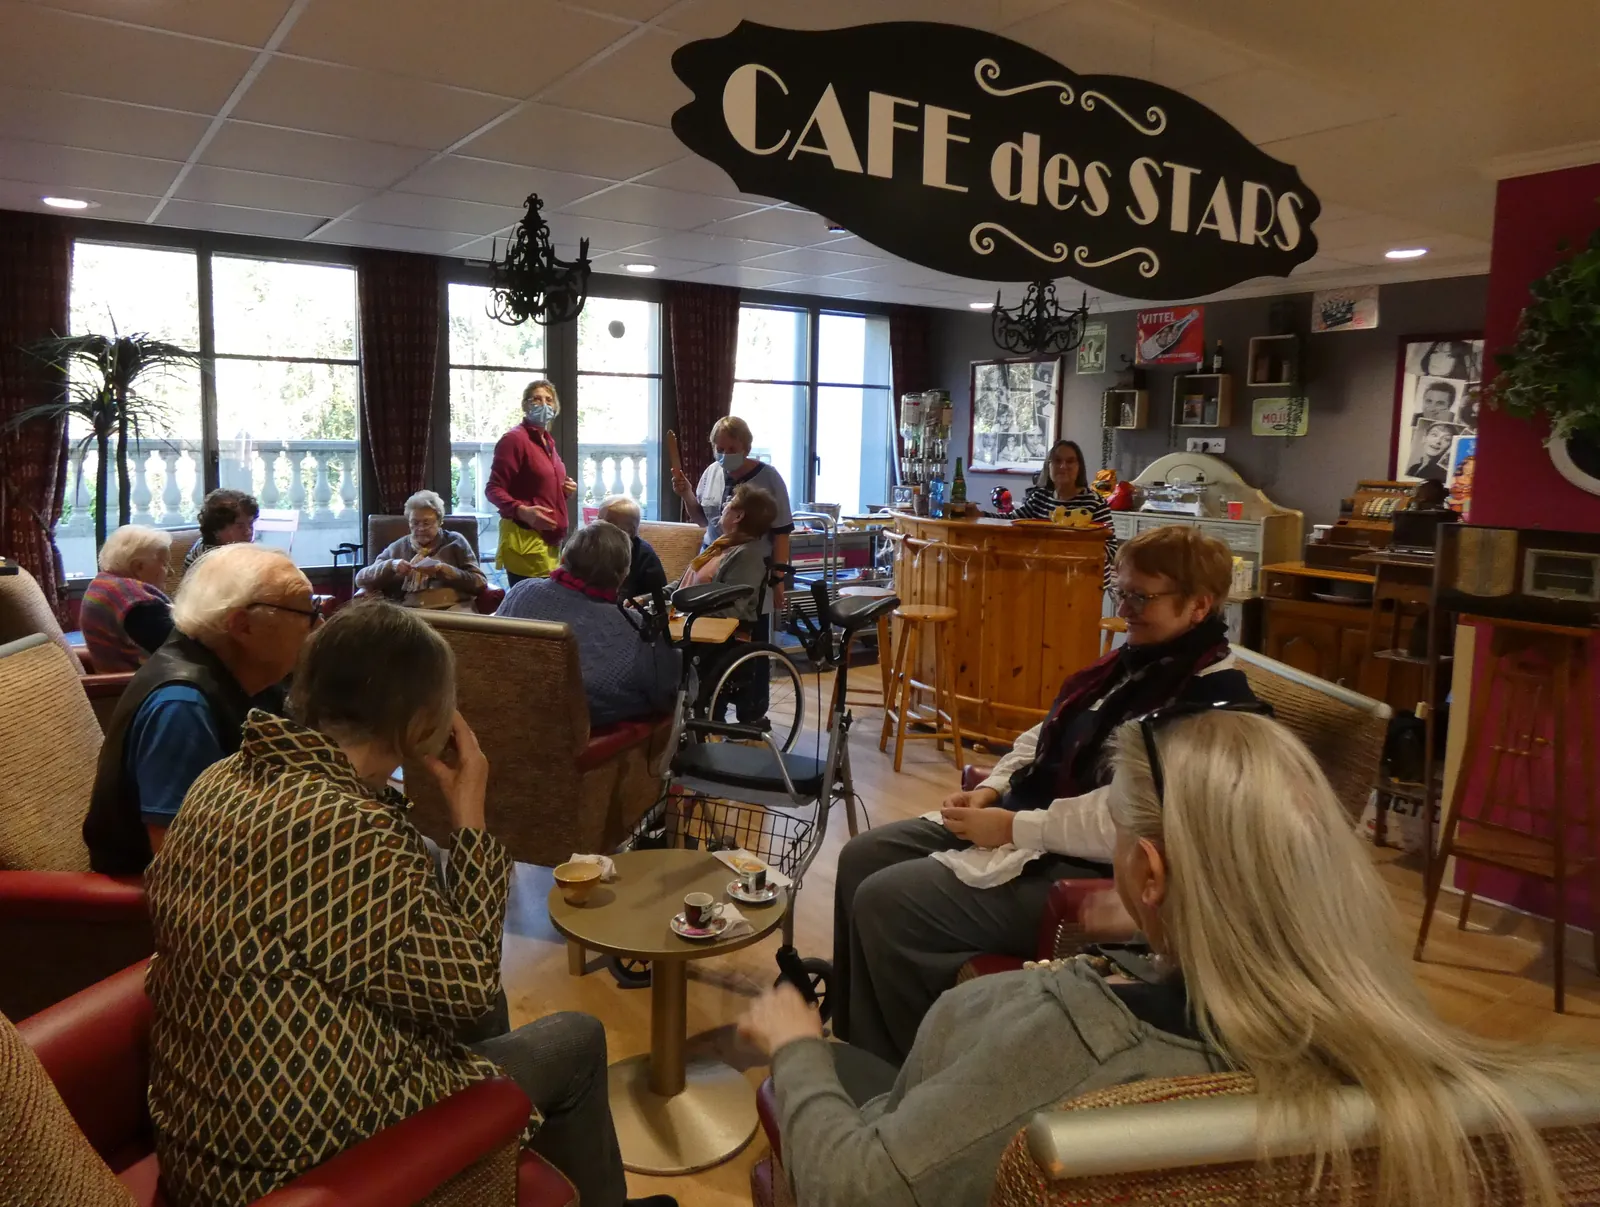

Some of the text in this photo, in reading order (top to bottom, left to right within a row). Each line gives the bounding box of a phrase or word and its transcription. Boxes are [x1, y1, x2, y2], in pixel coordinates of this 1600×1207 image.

[722, 63, 1305, 252] CAFE des STARS
[1141, 312, 1176, 324] VITTEL
